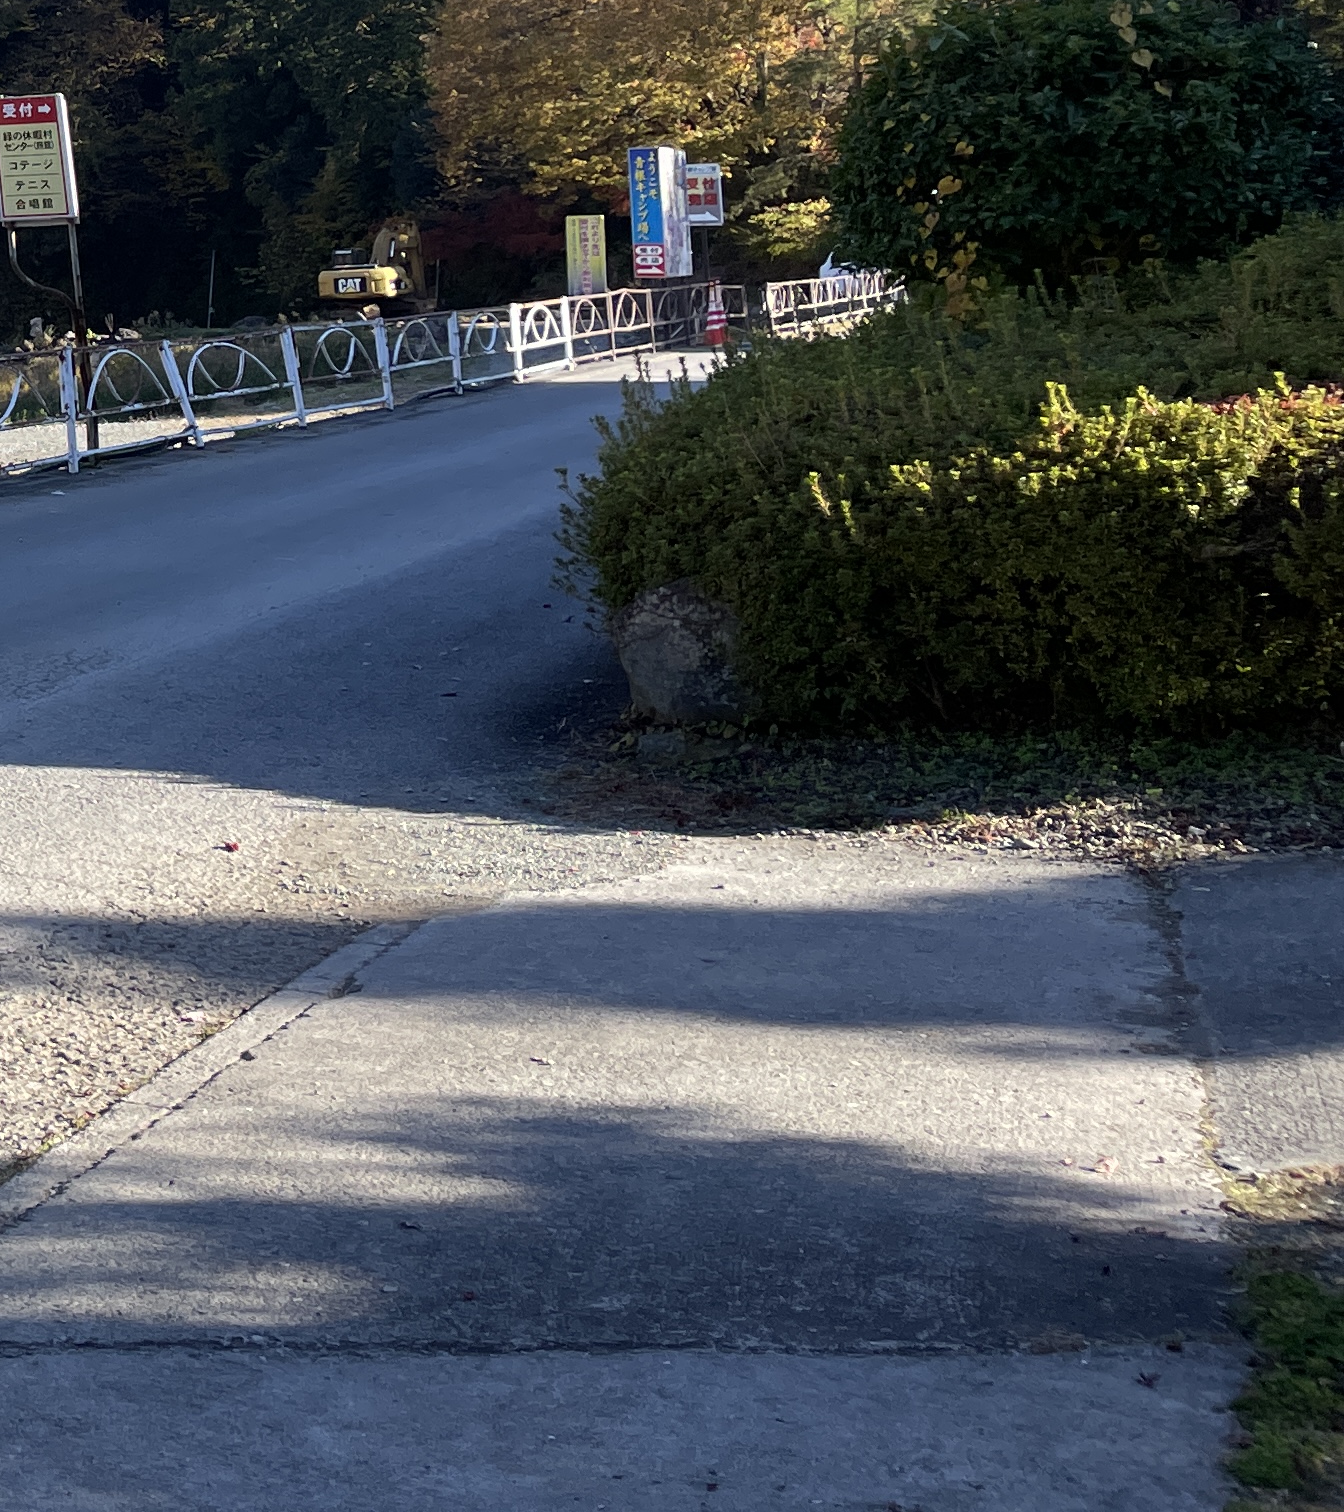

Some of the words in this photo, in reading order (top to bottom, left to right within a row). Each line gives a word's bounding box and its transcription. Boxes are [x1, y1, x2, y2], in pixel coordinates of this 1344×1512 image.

[3, 103, 33, 118] 受付
[9, 159, 53, 170] コテージ
[648, 151, 658, 200] ようこそ
[15, 180, 50, 191] テニス
[338, 278, 361, 293] CAT
